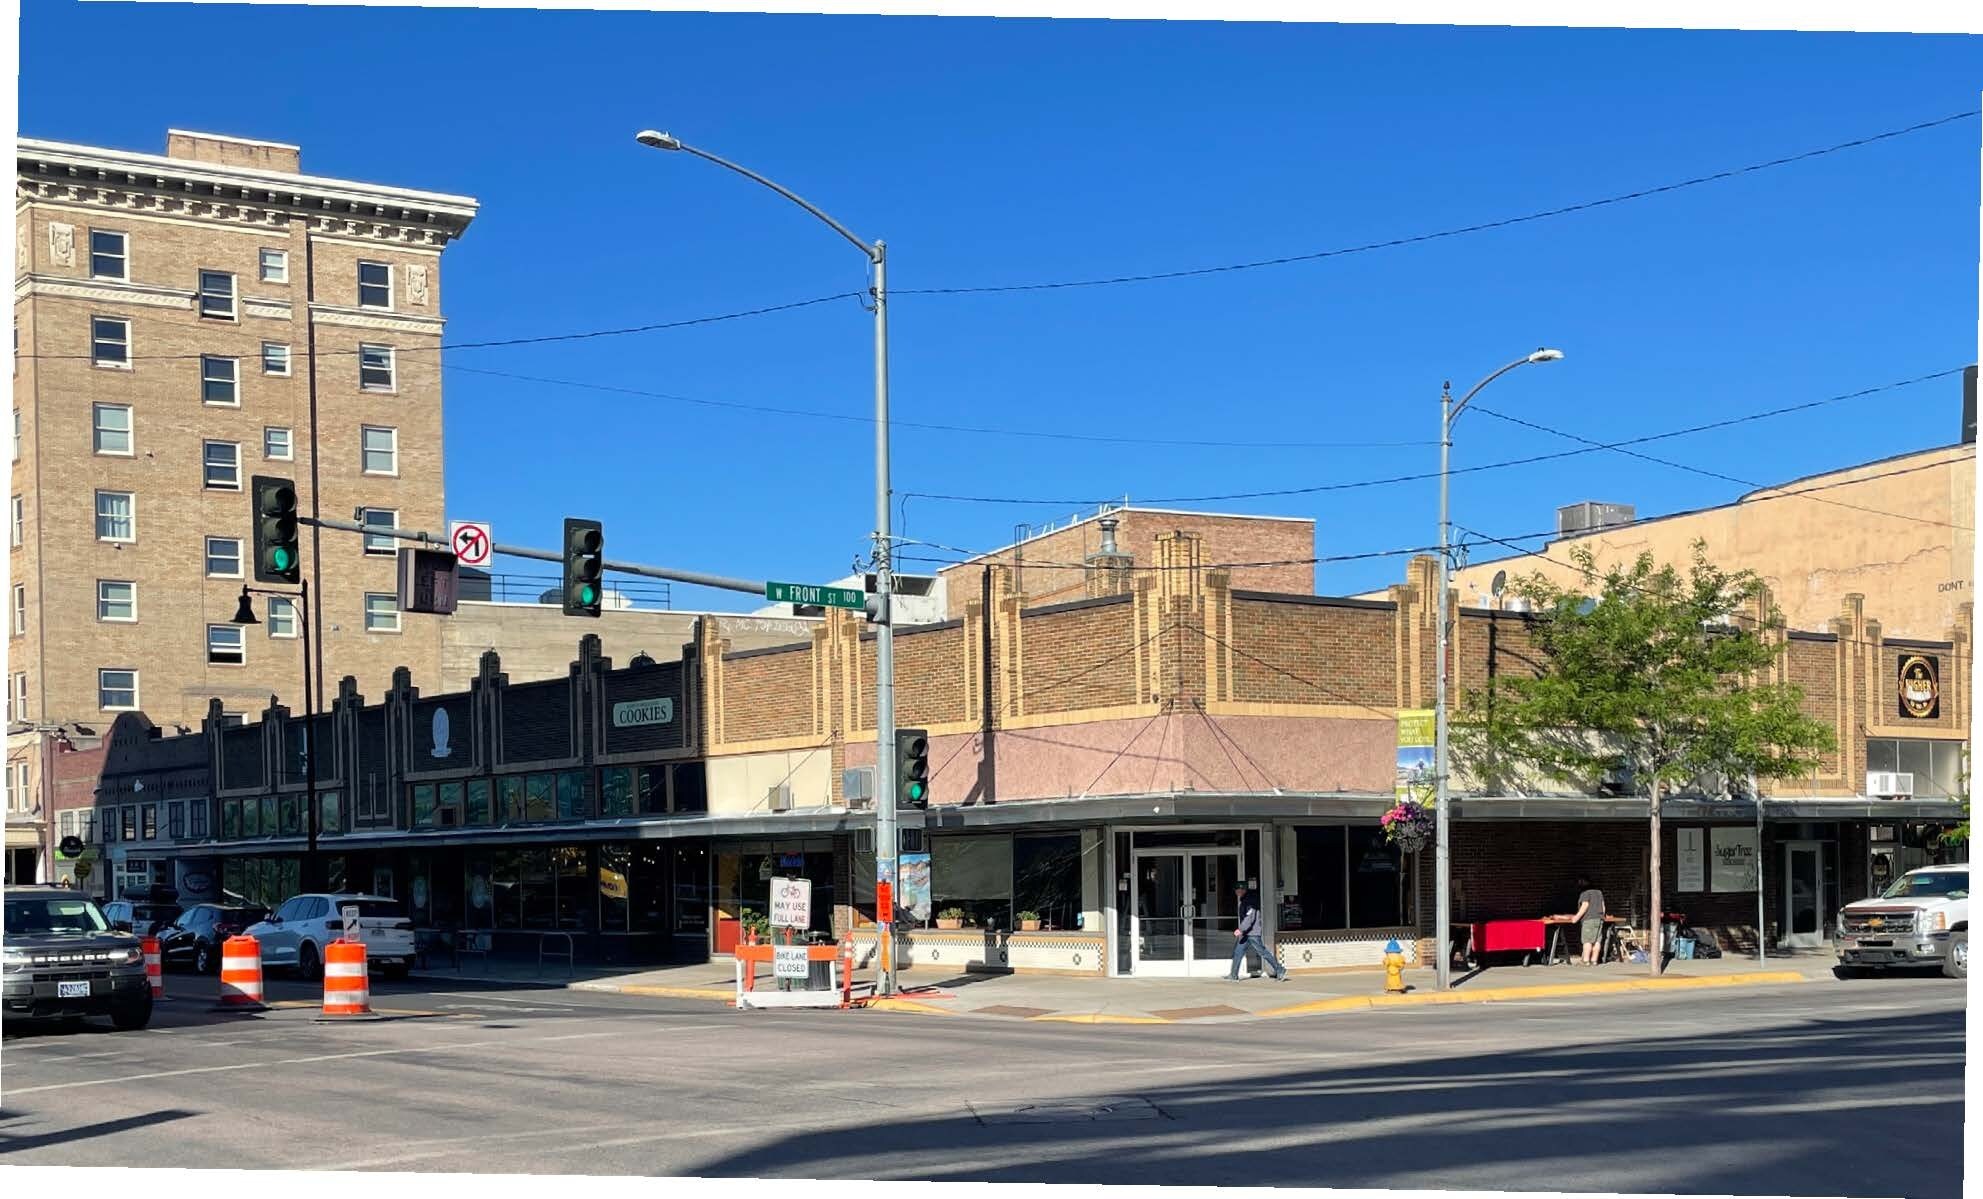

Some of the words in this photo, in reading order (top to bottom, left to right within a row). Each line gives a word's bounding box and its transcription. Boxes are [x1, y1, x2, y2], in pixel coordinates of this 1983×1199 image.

[1938, 580, 1964, 593] DONT
[775, 588, 783, 600] W
[789, 585, 821, 602] FRONT
[827, 592, 836, 604] ST
[843, 591, 856, 603] 100
[619, 704, 667, 724] COOKIES
[774, 902, 790, 911] MAY
[792, 902, 807, 912] USE
[774, 914, 789, 923] FULL
[790, 914, 806, 924] LANE
[776, 951, 789, 961] BIKE
[790, 951, 807, 961] LANE
[777, 963, 806, 973] CLOSED
